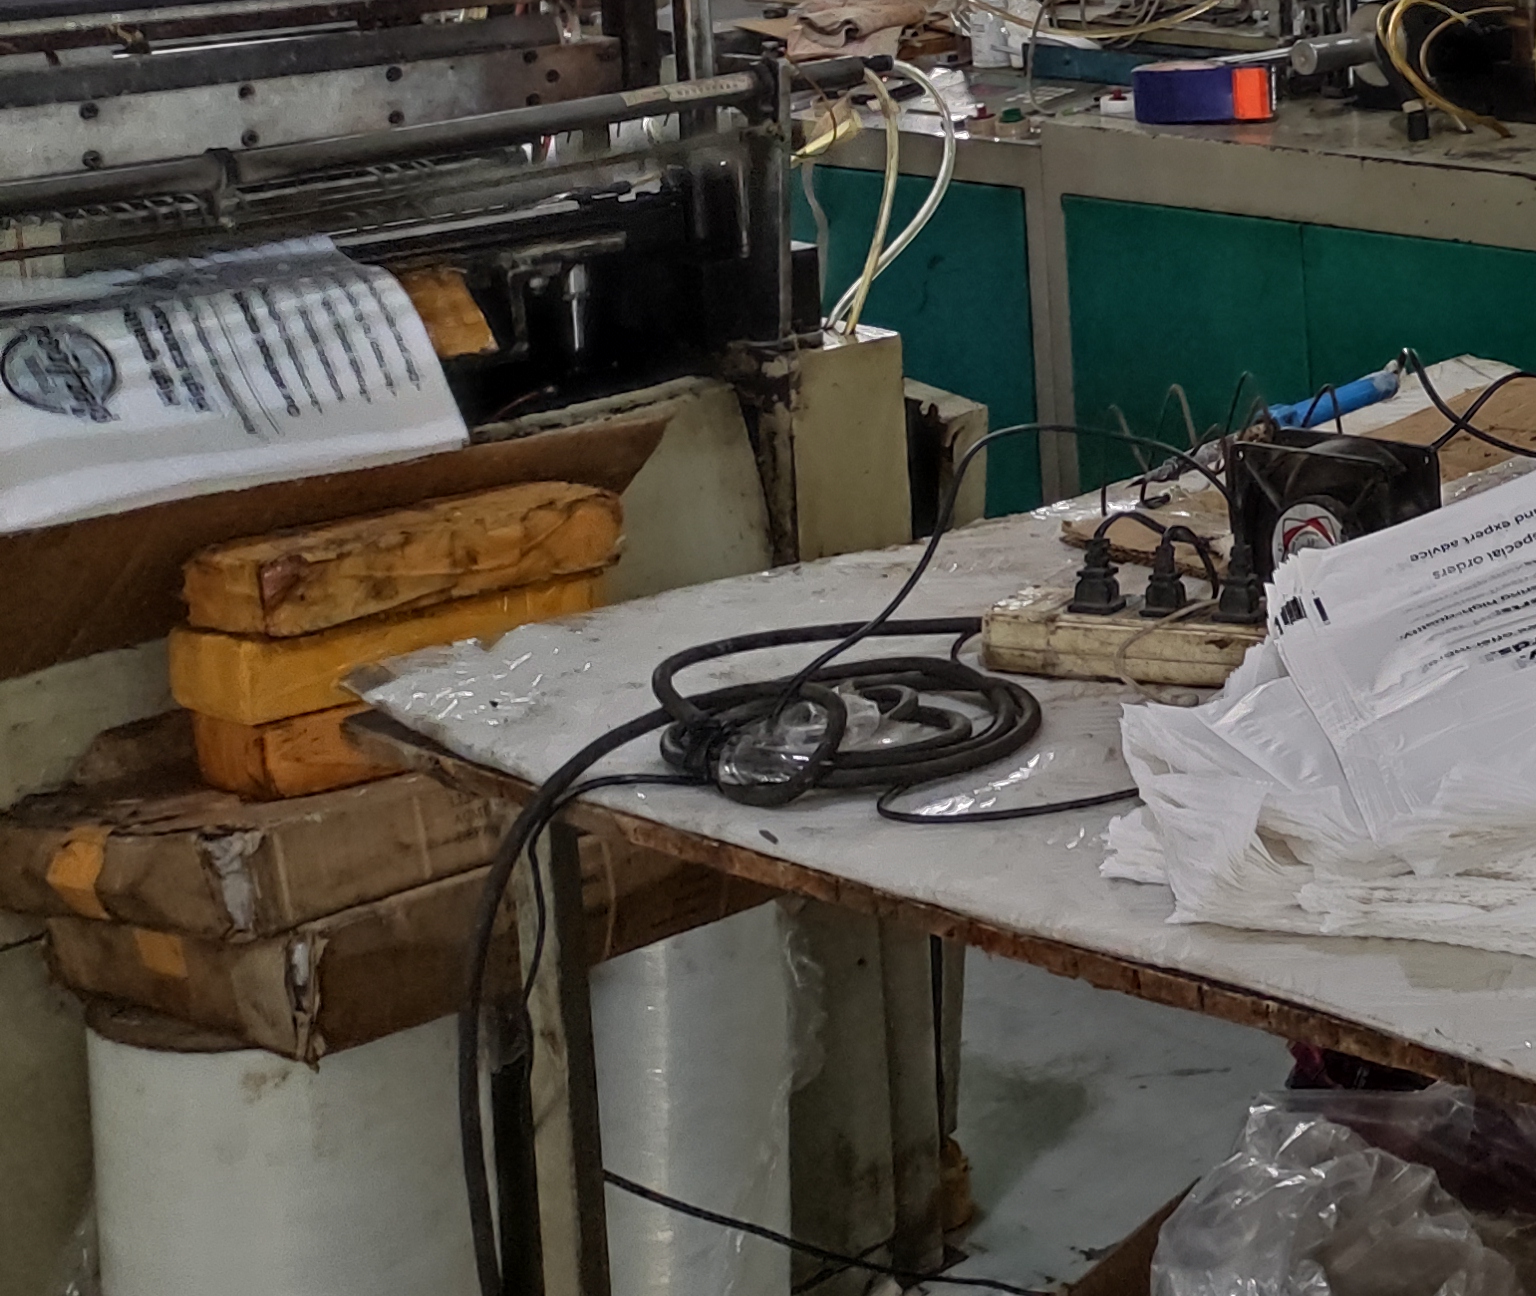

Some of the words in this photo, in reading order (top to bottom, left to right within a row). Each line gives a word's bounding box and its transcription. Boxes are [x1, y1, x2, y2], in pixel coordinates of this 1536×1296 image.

[1461, 518, 1511, 545] expert
[1408, 537, 1458, 563] advice
[1431, 555, 1484, 580] orders
